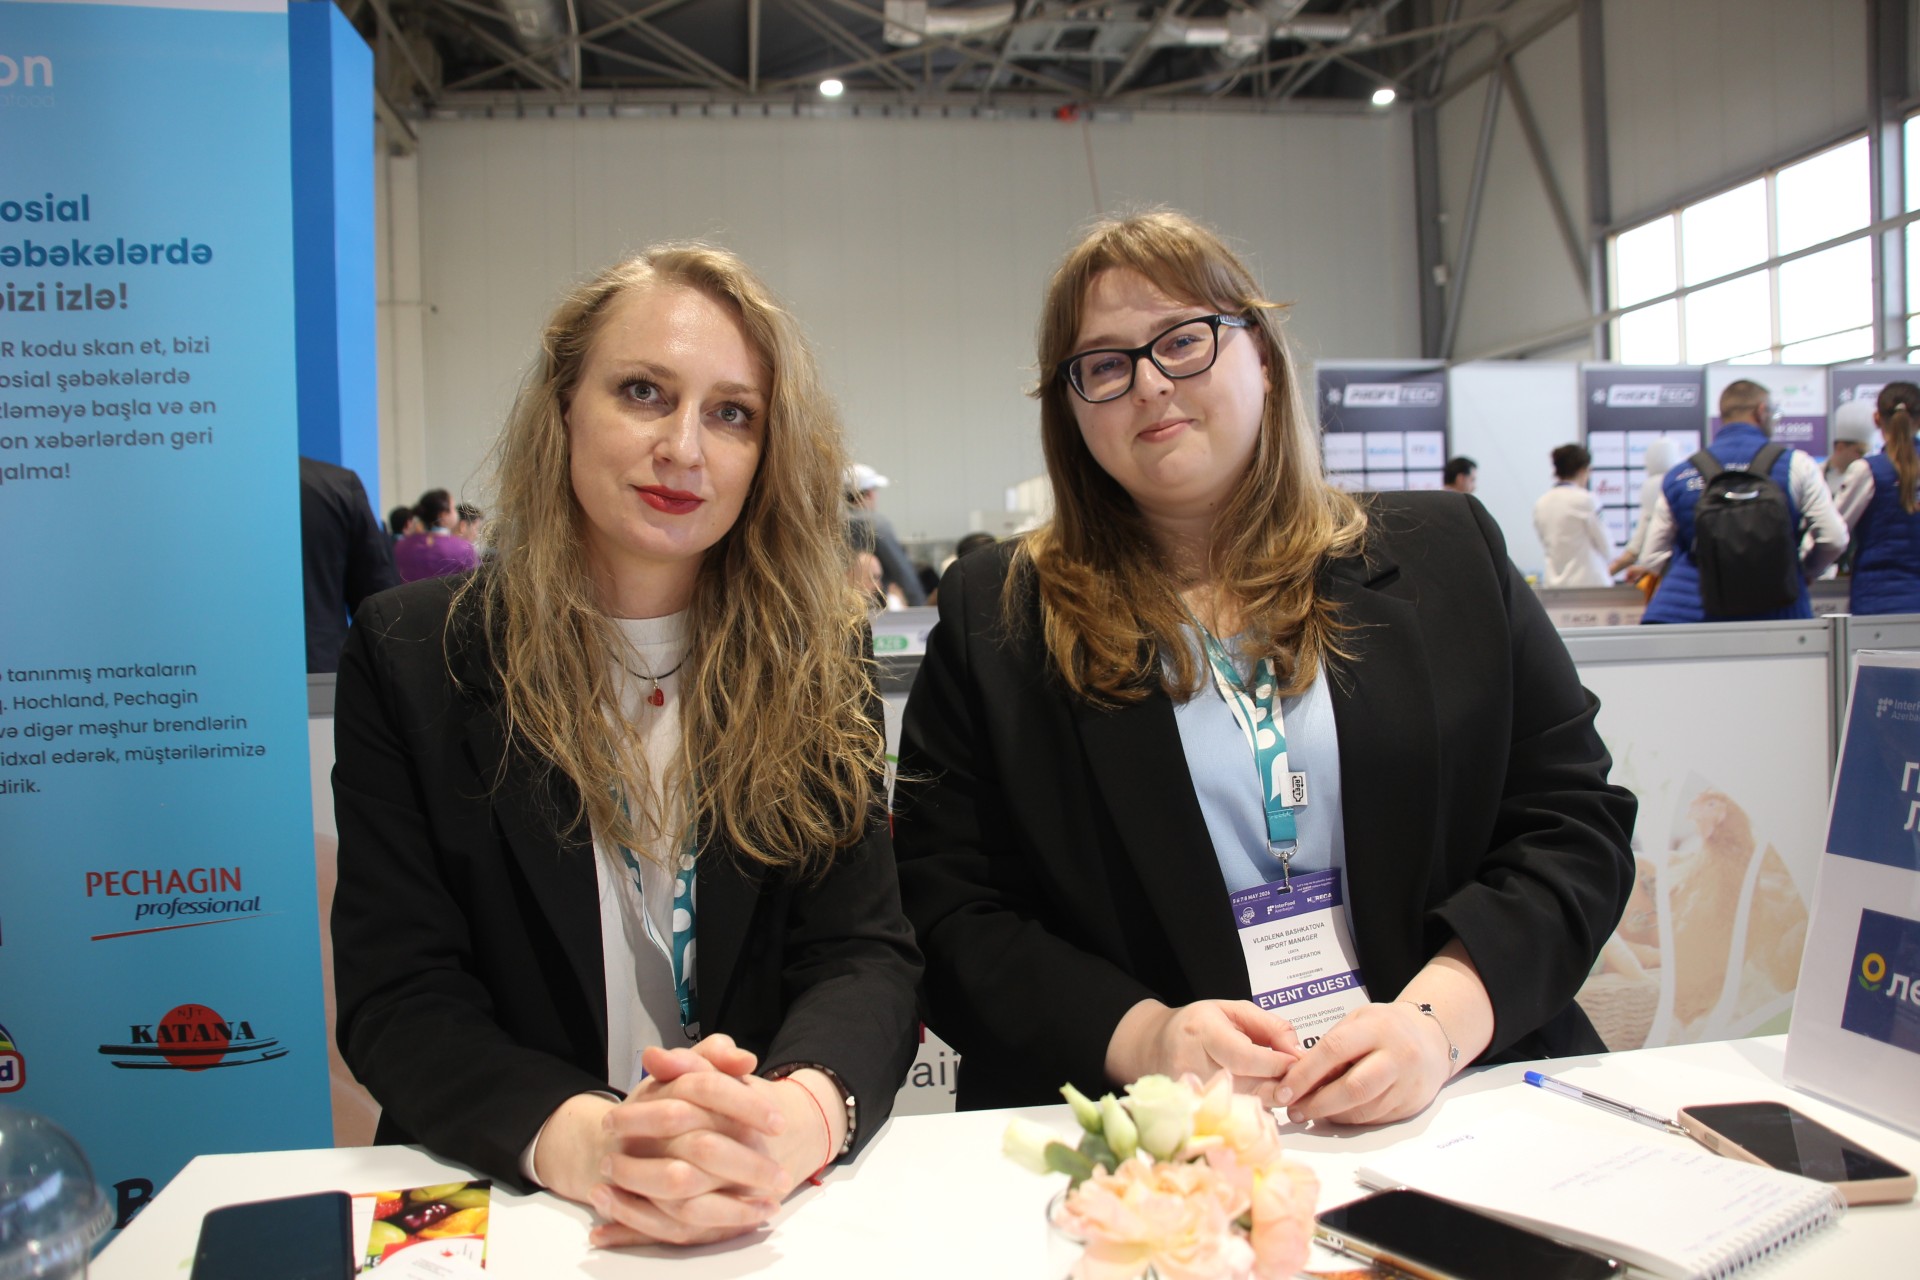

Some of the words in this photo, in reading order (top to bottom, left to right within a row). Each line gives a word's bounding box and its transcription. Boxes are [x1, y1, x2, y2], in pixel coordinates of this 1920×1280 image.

[0, 192, 89, 222] osial
[0, 237, 213, 267] əbəkələrdə
[0, 282, 46, 312] izi
[56, 282, 128, 311] izlə!
[0, 341, 15, 358] R
[21, 340, 77, 357] kodu
[83, 339, 134, 356] skan
[140, 338, 167, 356] et,
[173, 336, 210, 353] bizi
[0, 371, 50, 388] osial
[57, 368, 191, 392] şəbəkələrdə
[0, 402, 86, 422] ləməyə
[92, 400, 151, 421] başla
[158, 401, 184, 415] və
[189, 400, 217, 415] ən
[1, 435, 28, 449] on
[34, 430, 164, 449] xəbərlərdən
[170, 427, 213, 450] geri
[0, 462, 70, 485] alma!
[8, 665, 92, 684] tanınmış
[97, 663, 197, 680] markaların
[13, 692, 109, 711] Hochland,
[114, 689, 198, 708] Pechagin
[24, 721, 73, 741] digər
[79, 718, 148, 738] məşhur
[153, 716, 248, 734] brendlərin
[1, 750, 46, 767] idxal
[52, 747, 120, 765] edərək,
[125, 742, 266, 765] müştərilərimizə
[86, 867, 242, 897] PECHAGIN
[135, 896, 261, 920] professional
[1252, 931, 1285, 944] VLADLENA
[1285, 922, 1325, 936] BASHKATOVA
[1264, 940, 1287, 951] IMPORT
[1288, 933, 1318, 945] MANAGER
[1270, 957, 1291, 967] RUSSIAN
[1291, 950, 1321, 962] FEDERATION
[1259, 987, 1304, 1008] EVENT
[1307, 975, 1352, 996] GUEST
[130, 1021, 256, 1045] KATANA
[900, 1051, 959, 1095] aij
